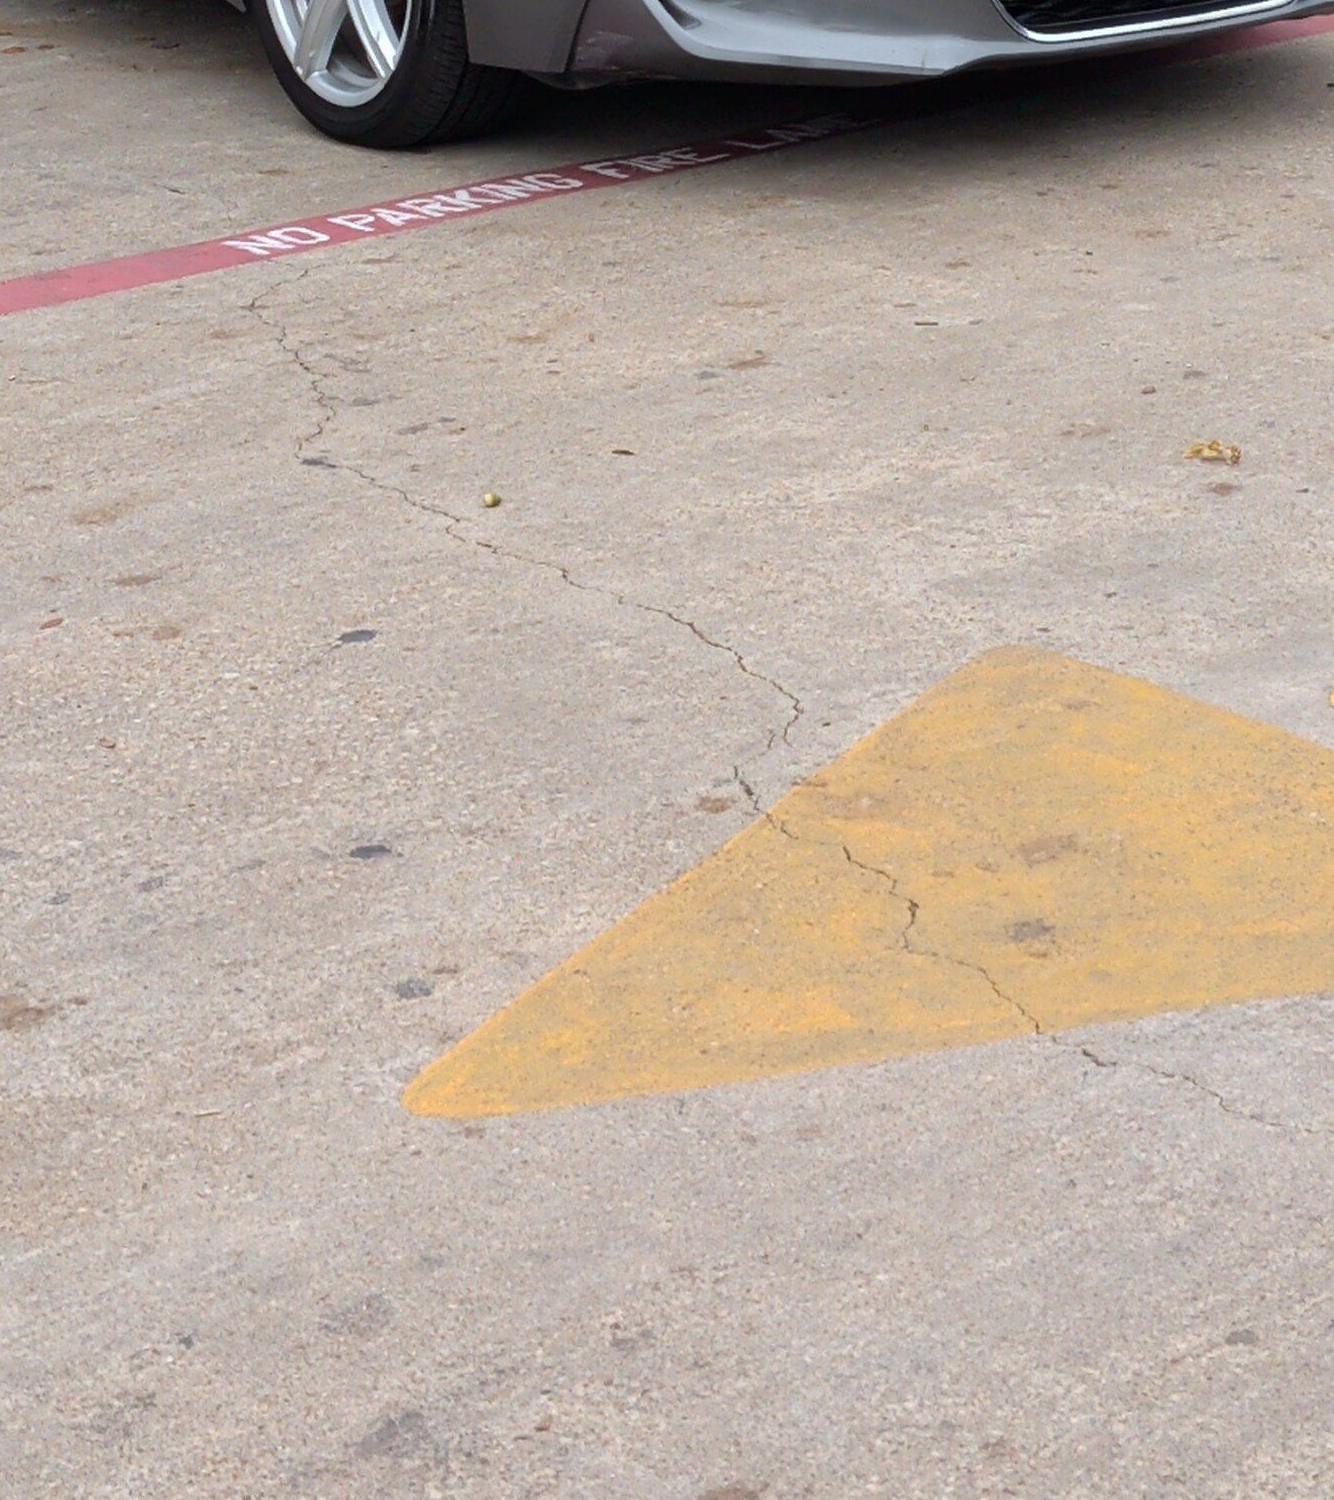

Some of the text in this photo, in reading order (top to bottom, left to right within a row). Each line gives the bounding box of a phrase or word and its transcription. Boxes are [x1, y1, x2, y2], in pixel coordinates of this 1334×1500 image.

[221, 226, 330, 256] NO
[327, 173, 584, 232] PARKING
[580, 147, 731, 180] FIRE
